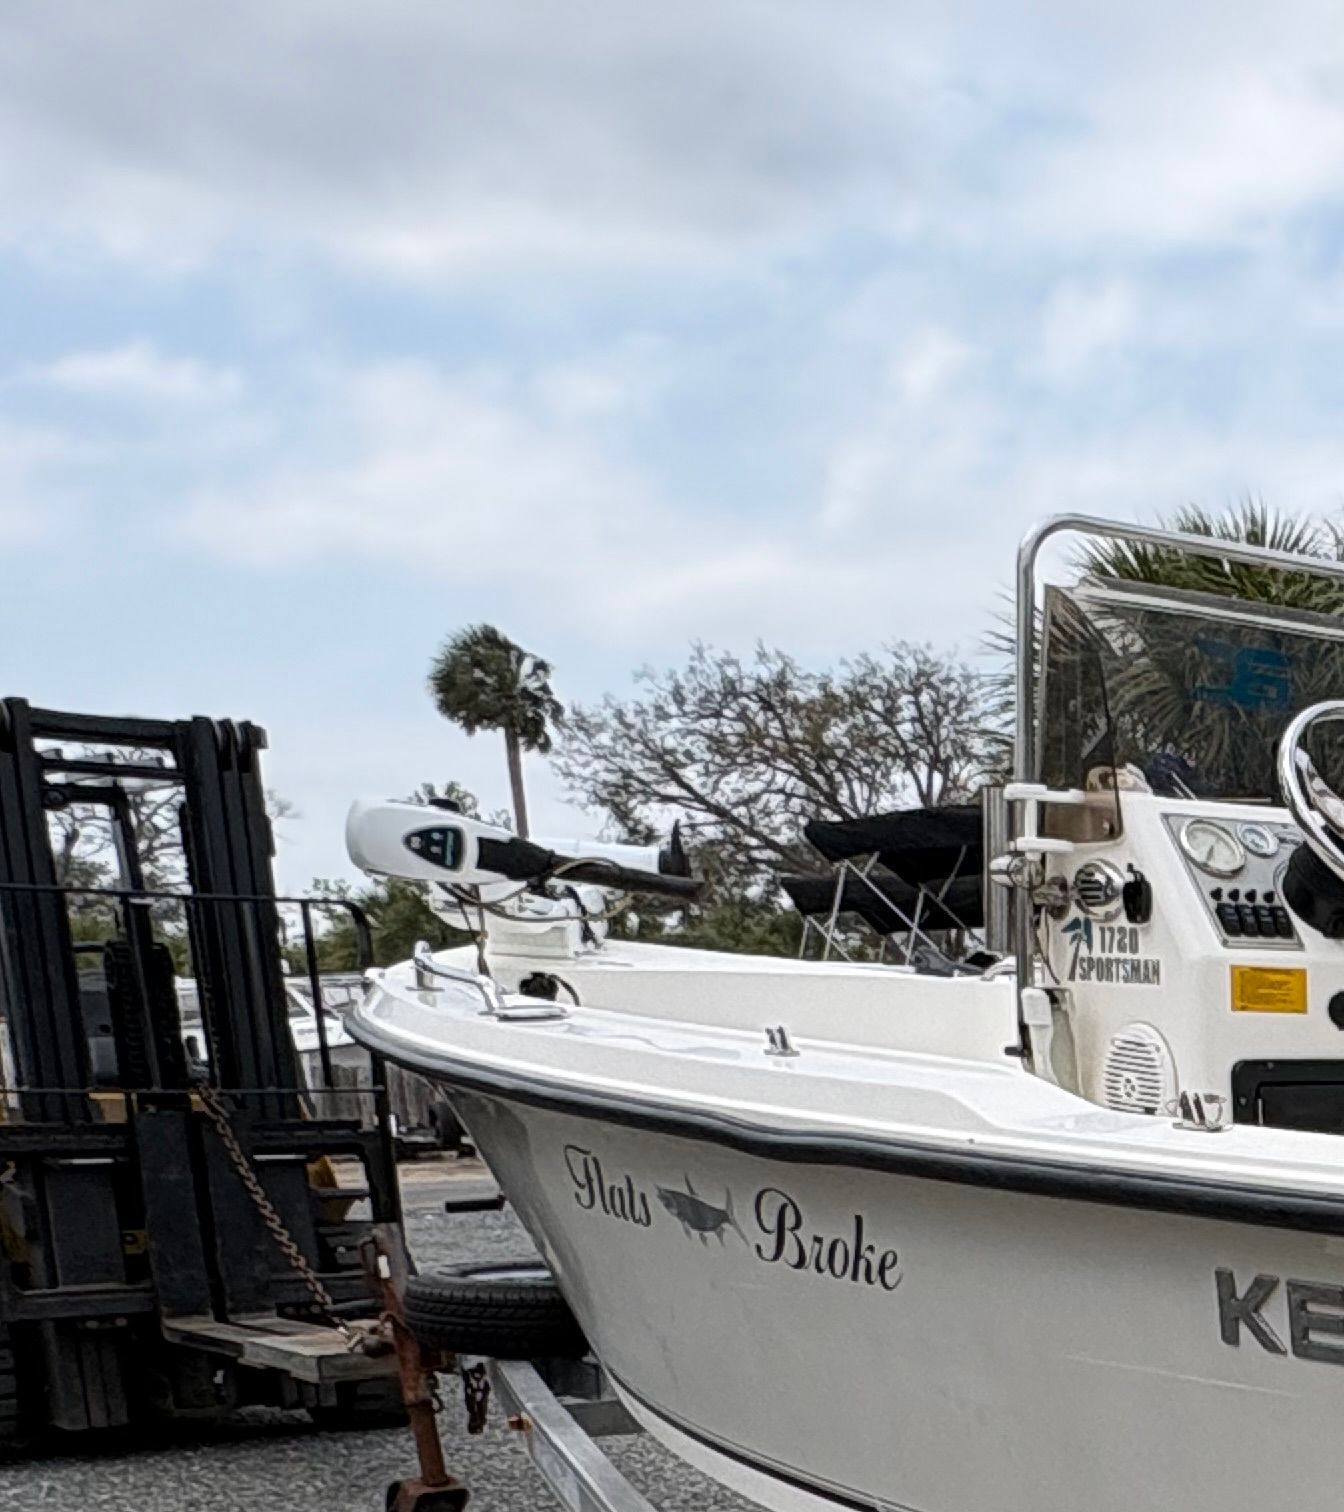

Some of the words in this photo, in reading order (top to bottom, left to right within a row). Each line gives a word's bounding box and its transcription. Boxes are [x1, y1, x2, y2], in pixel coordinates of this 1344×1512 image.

[1078, 955, 1161, 986] SPORTSMAN
[562, 1143, 653, 1229] Flats
[753, 1186, 903, 1291] Broke
